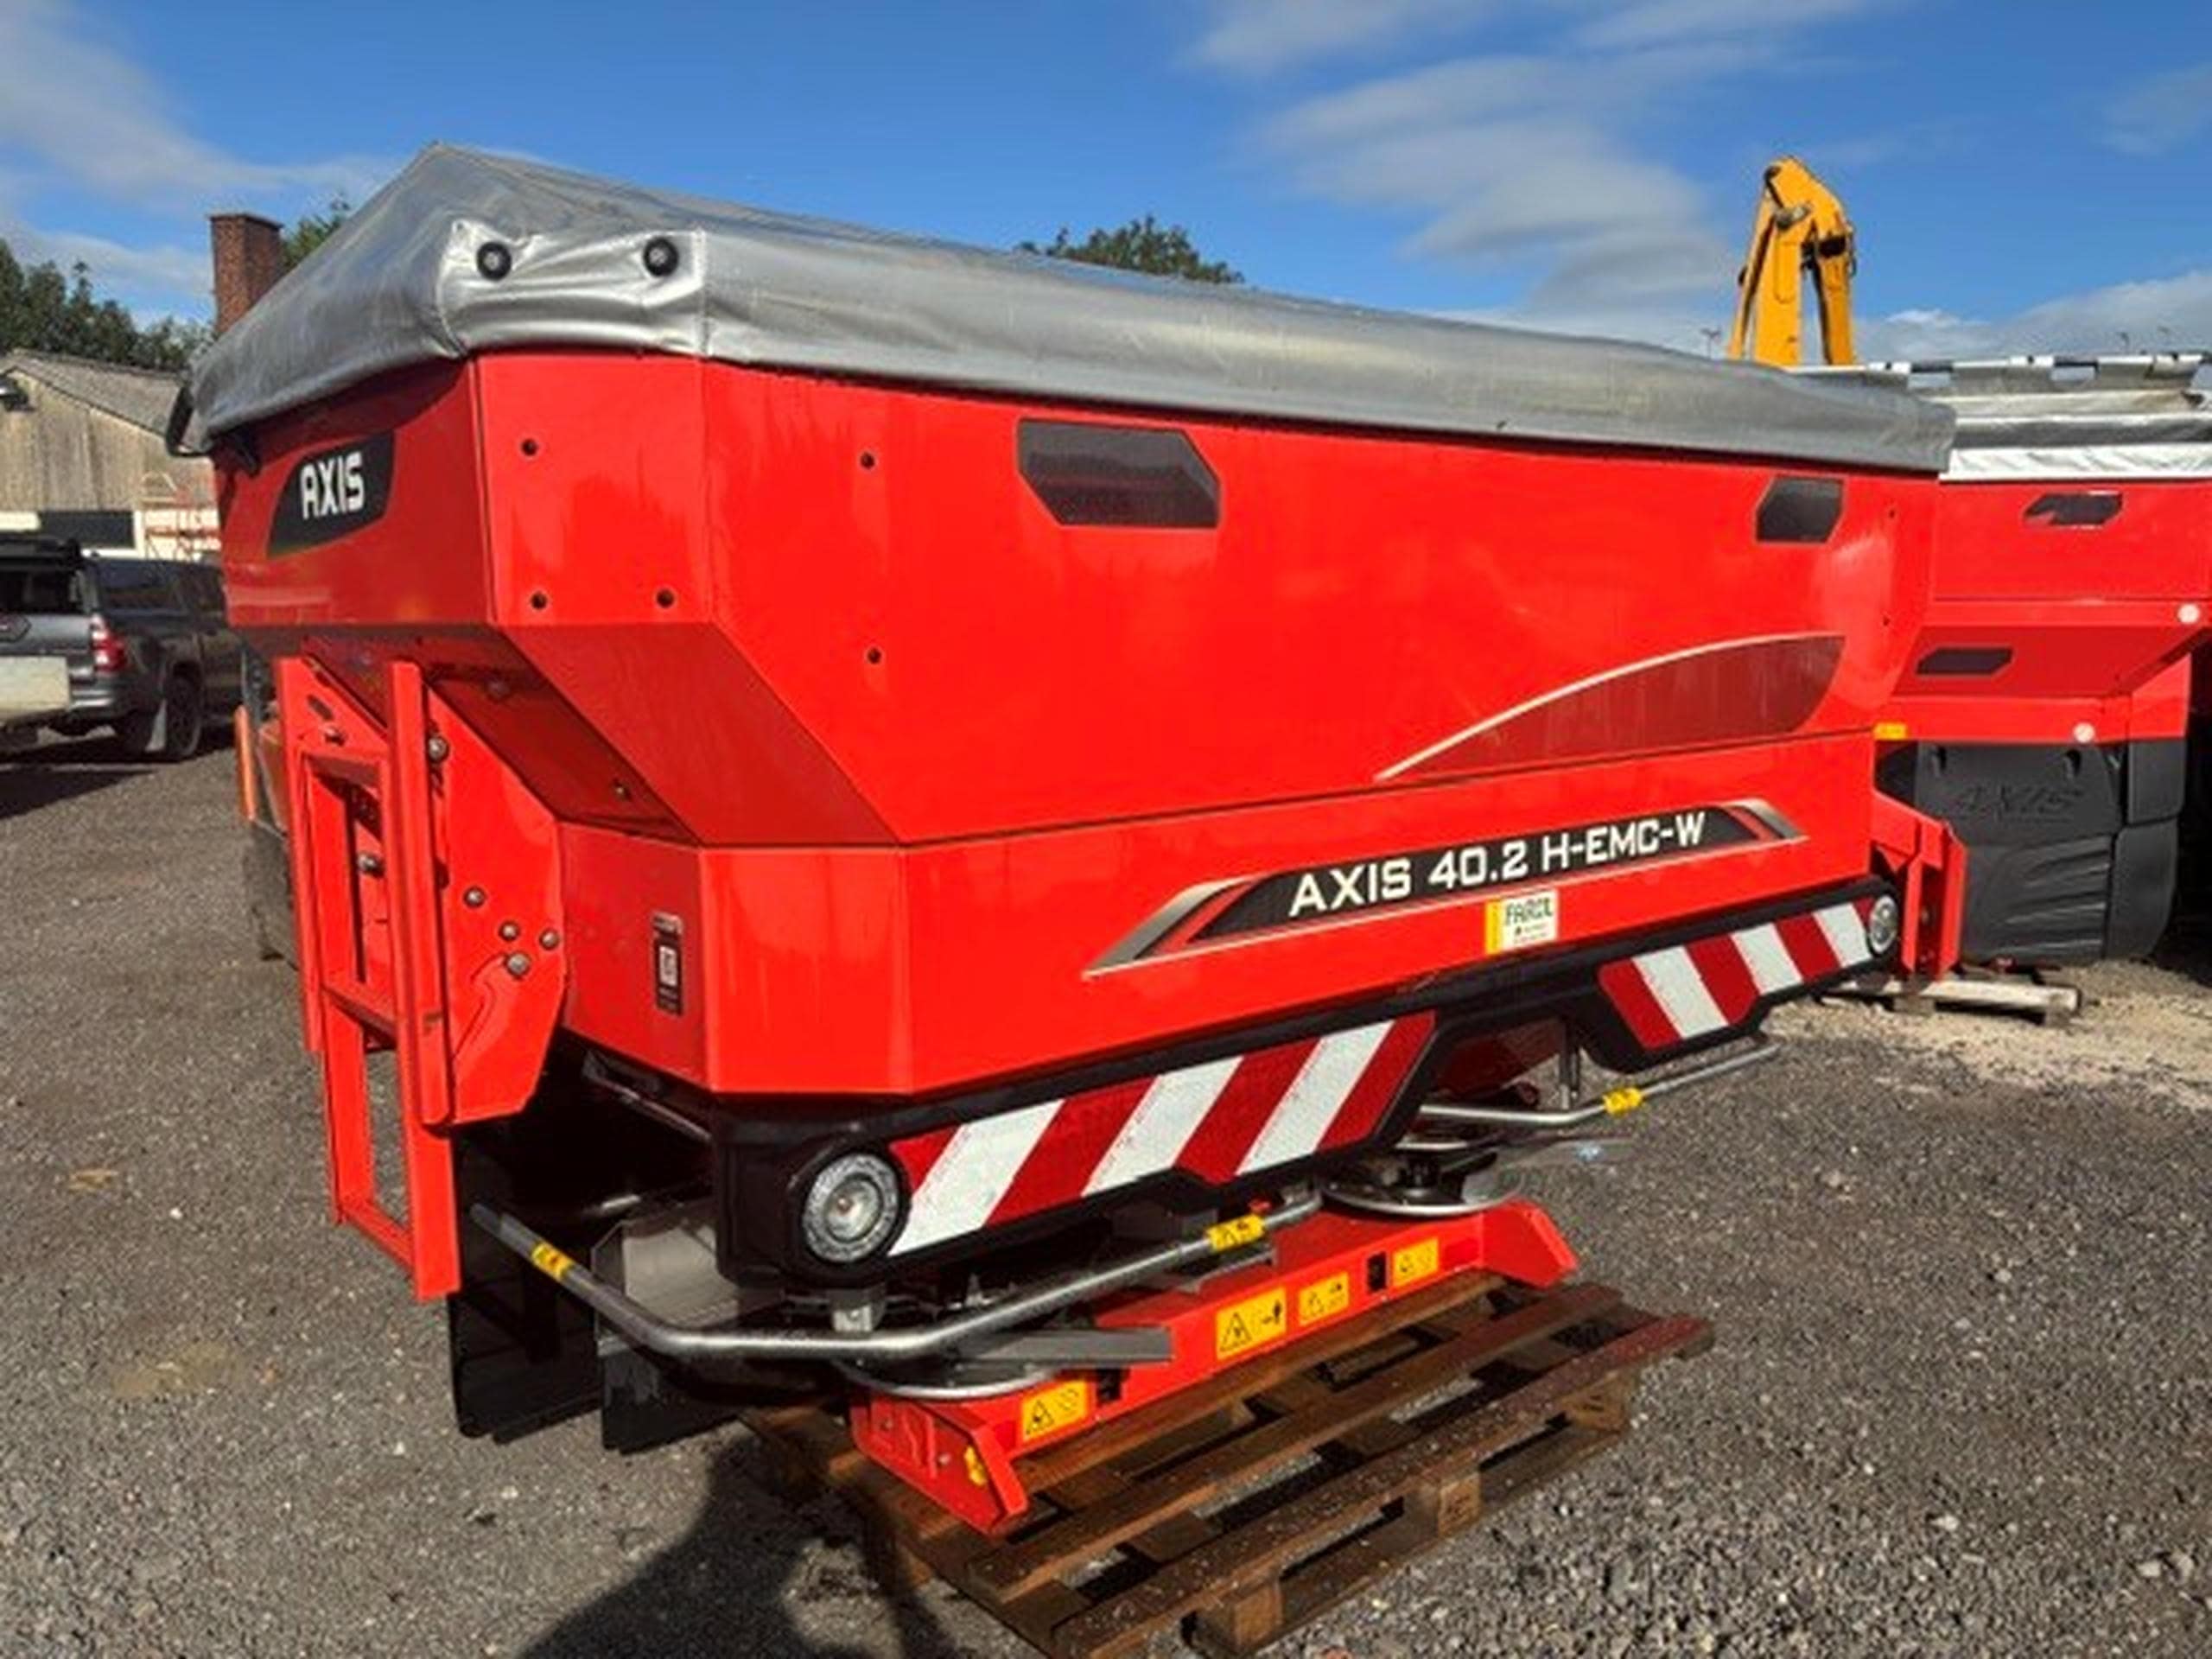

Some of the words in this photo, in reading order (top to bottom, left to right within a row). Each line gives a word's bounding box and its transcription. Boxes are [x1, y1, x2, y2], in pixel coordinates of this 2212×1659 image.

[300, 451, 365, 519] AXIS
[1288, 858, 1411, 918] AXIS
[1428, 840, 1529, 889] 40.2
[1541, 810, 1706, 873] H-EMC-W
